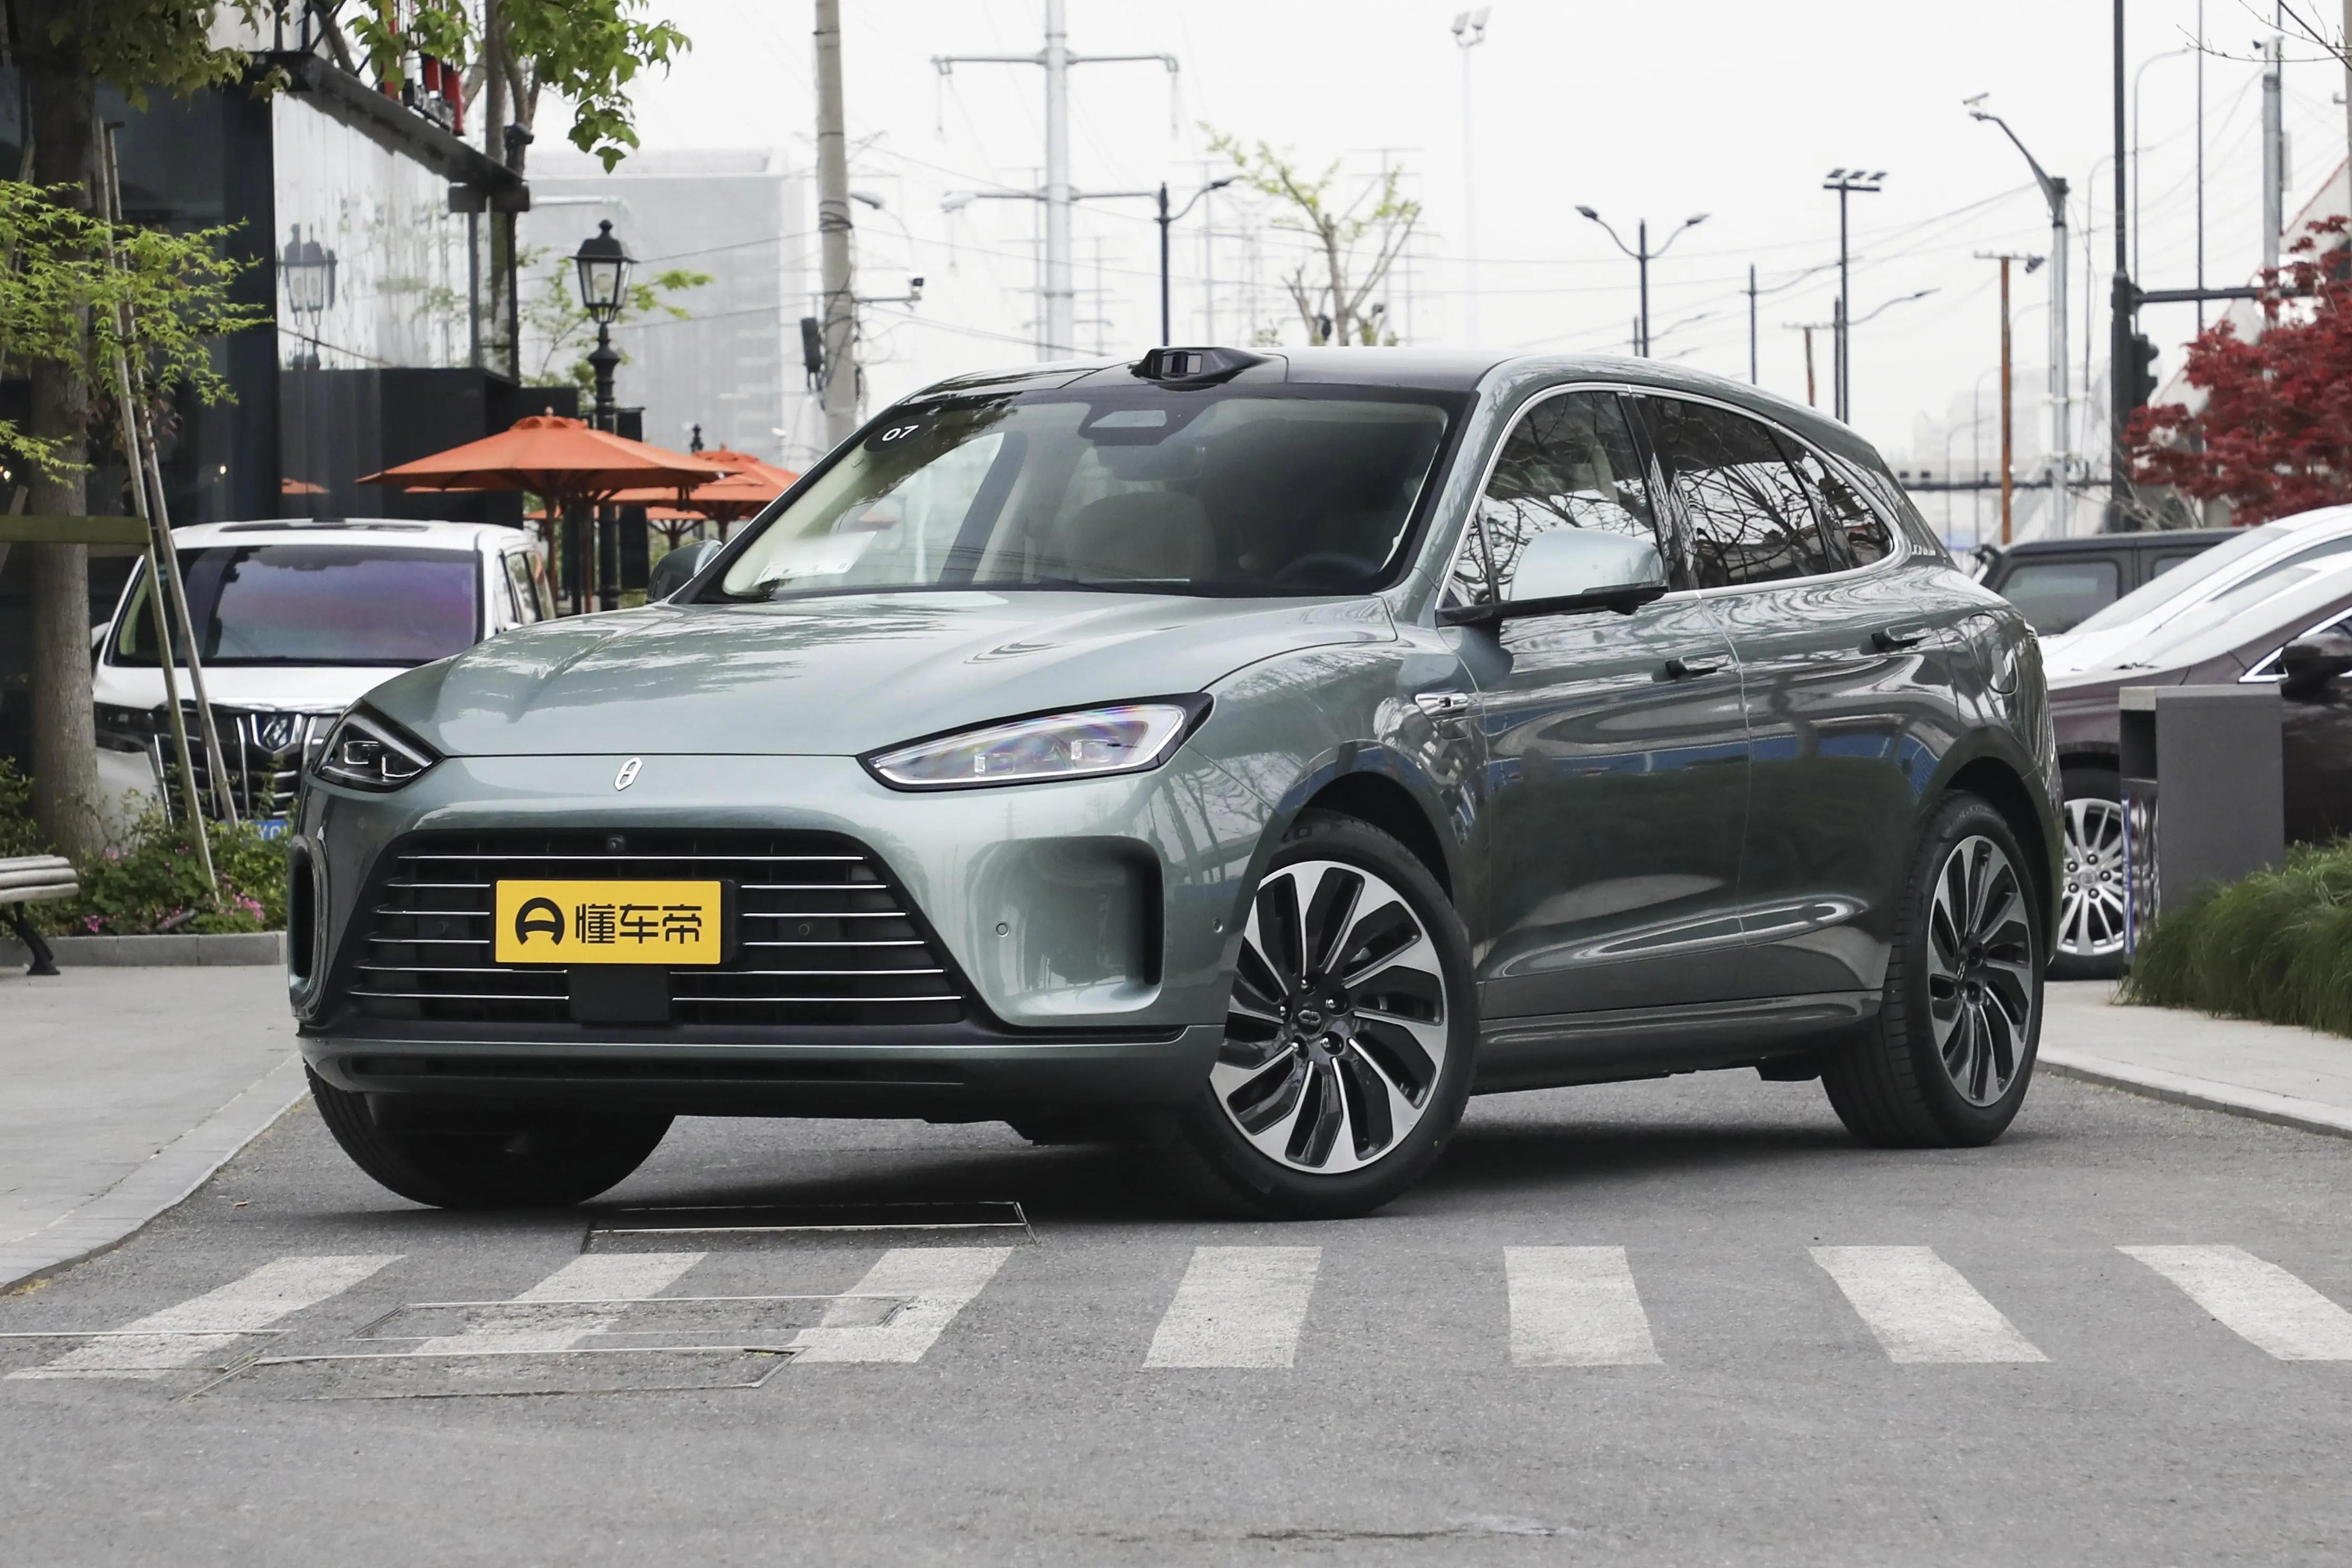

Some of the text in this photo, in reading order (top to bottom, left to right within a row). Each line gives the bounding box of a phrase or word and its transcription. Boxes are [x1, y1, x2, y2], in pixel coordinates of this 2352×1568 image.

[882, 424, 919, 442] 07
[575, 903, 702, 944] 懂车帝
